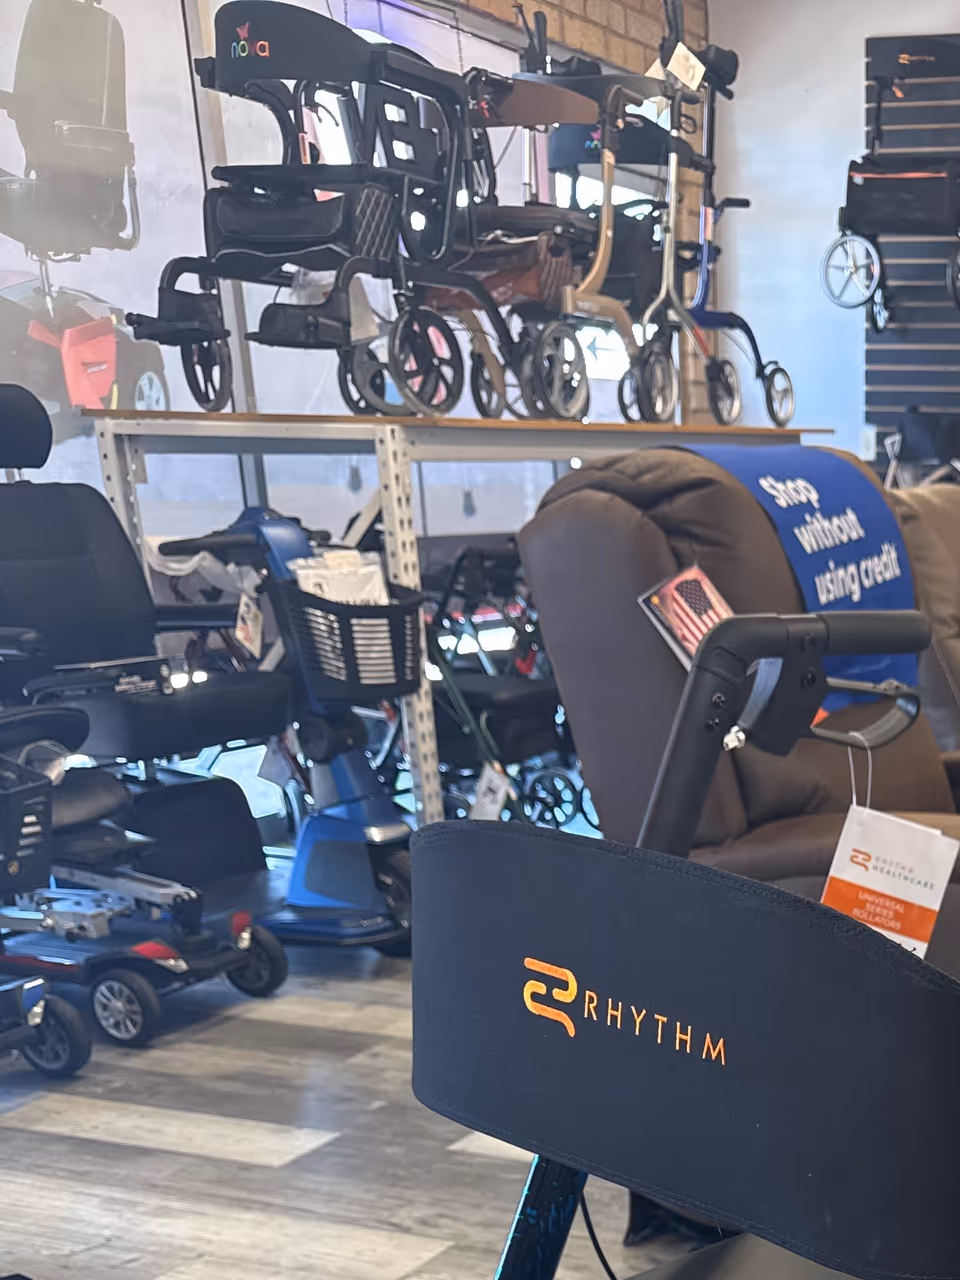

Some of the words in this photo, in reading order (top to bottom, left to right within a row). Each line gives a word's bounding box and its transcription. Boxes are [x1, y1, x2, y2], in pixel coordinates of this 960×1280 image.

[758, 475, 820, 509] Shop
[793, 506, 865, 554] without
[815, 559, 861, 605] using
[859, 541, 901, 589] credit
[872, 865, 935, 890] HEALTHCARE
[858, 890, 904, 914] UNIVERSAL
[865, 903, 894, 918] SERIES
[852, 907, 902, 930] ROLLATORS
[584, 990, 726, 1065] RHYTHM
